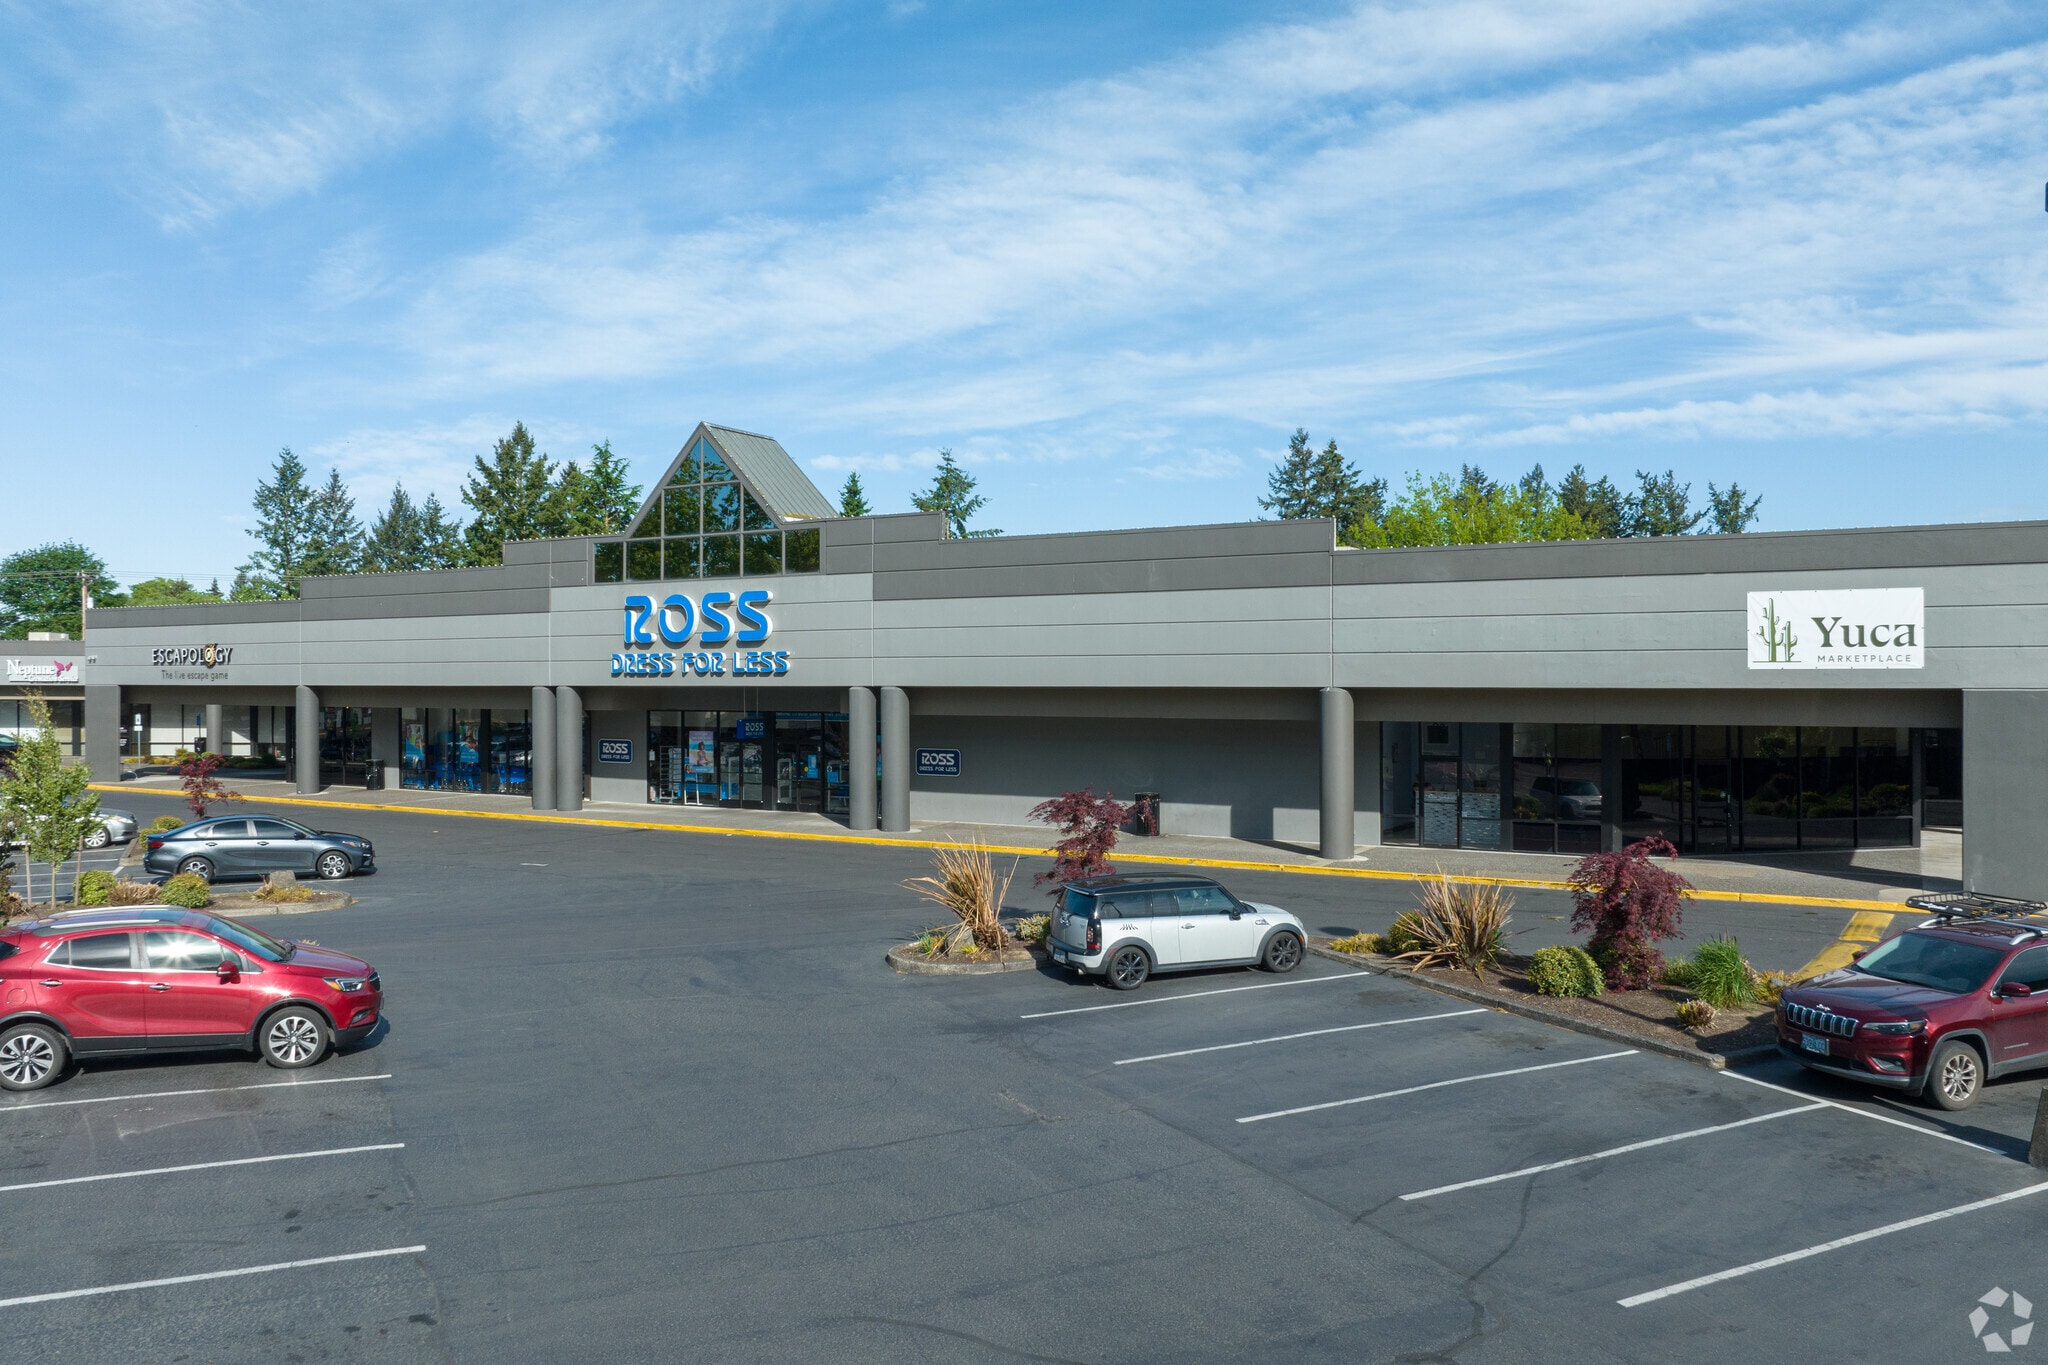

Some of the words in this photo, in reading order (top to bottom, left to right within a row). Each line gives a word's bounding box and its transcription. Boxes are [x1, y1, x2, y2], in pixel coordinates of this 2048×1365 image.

[624, 590, 774, 644] ROSS
[1811, 616, 1918, 648] Yuca
[151, 645, 233, 666] ESCAPOLOGY
[611, 652, 677, 675] DRESS
[682, 652, 727, 674] FOR
[733, 651, 791, 674] LESS
[1817, 654, 1912, 663] MARKETPLACE
[6, 658, 56, 677] Neptune
[161, 669, 173, 680] The
[745, 722, 764, 732] ROSS
[602, 742, 628, 754] ROSS
[921, 752, 955, 766] ROSS
